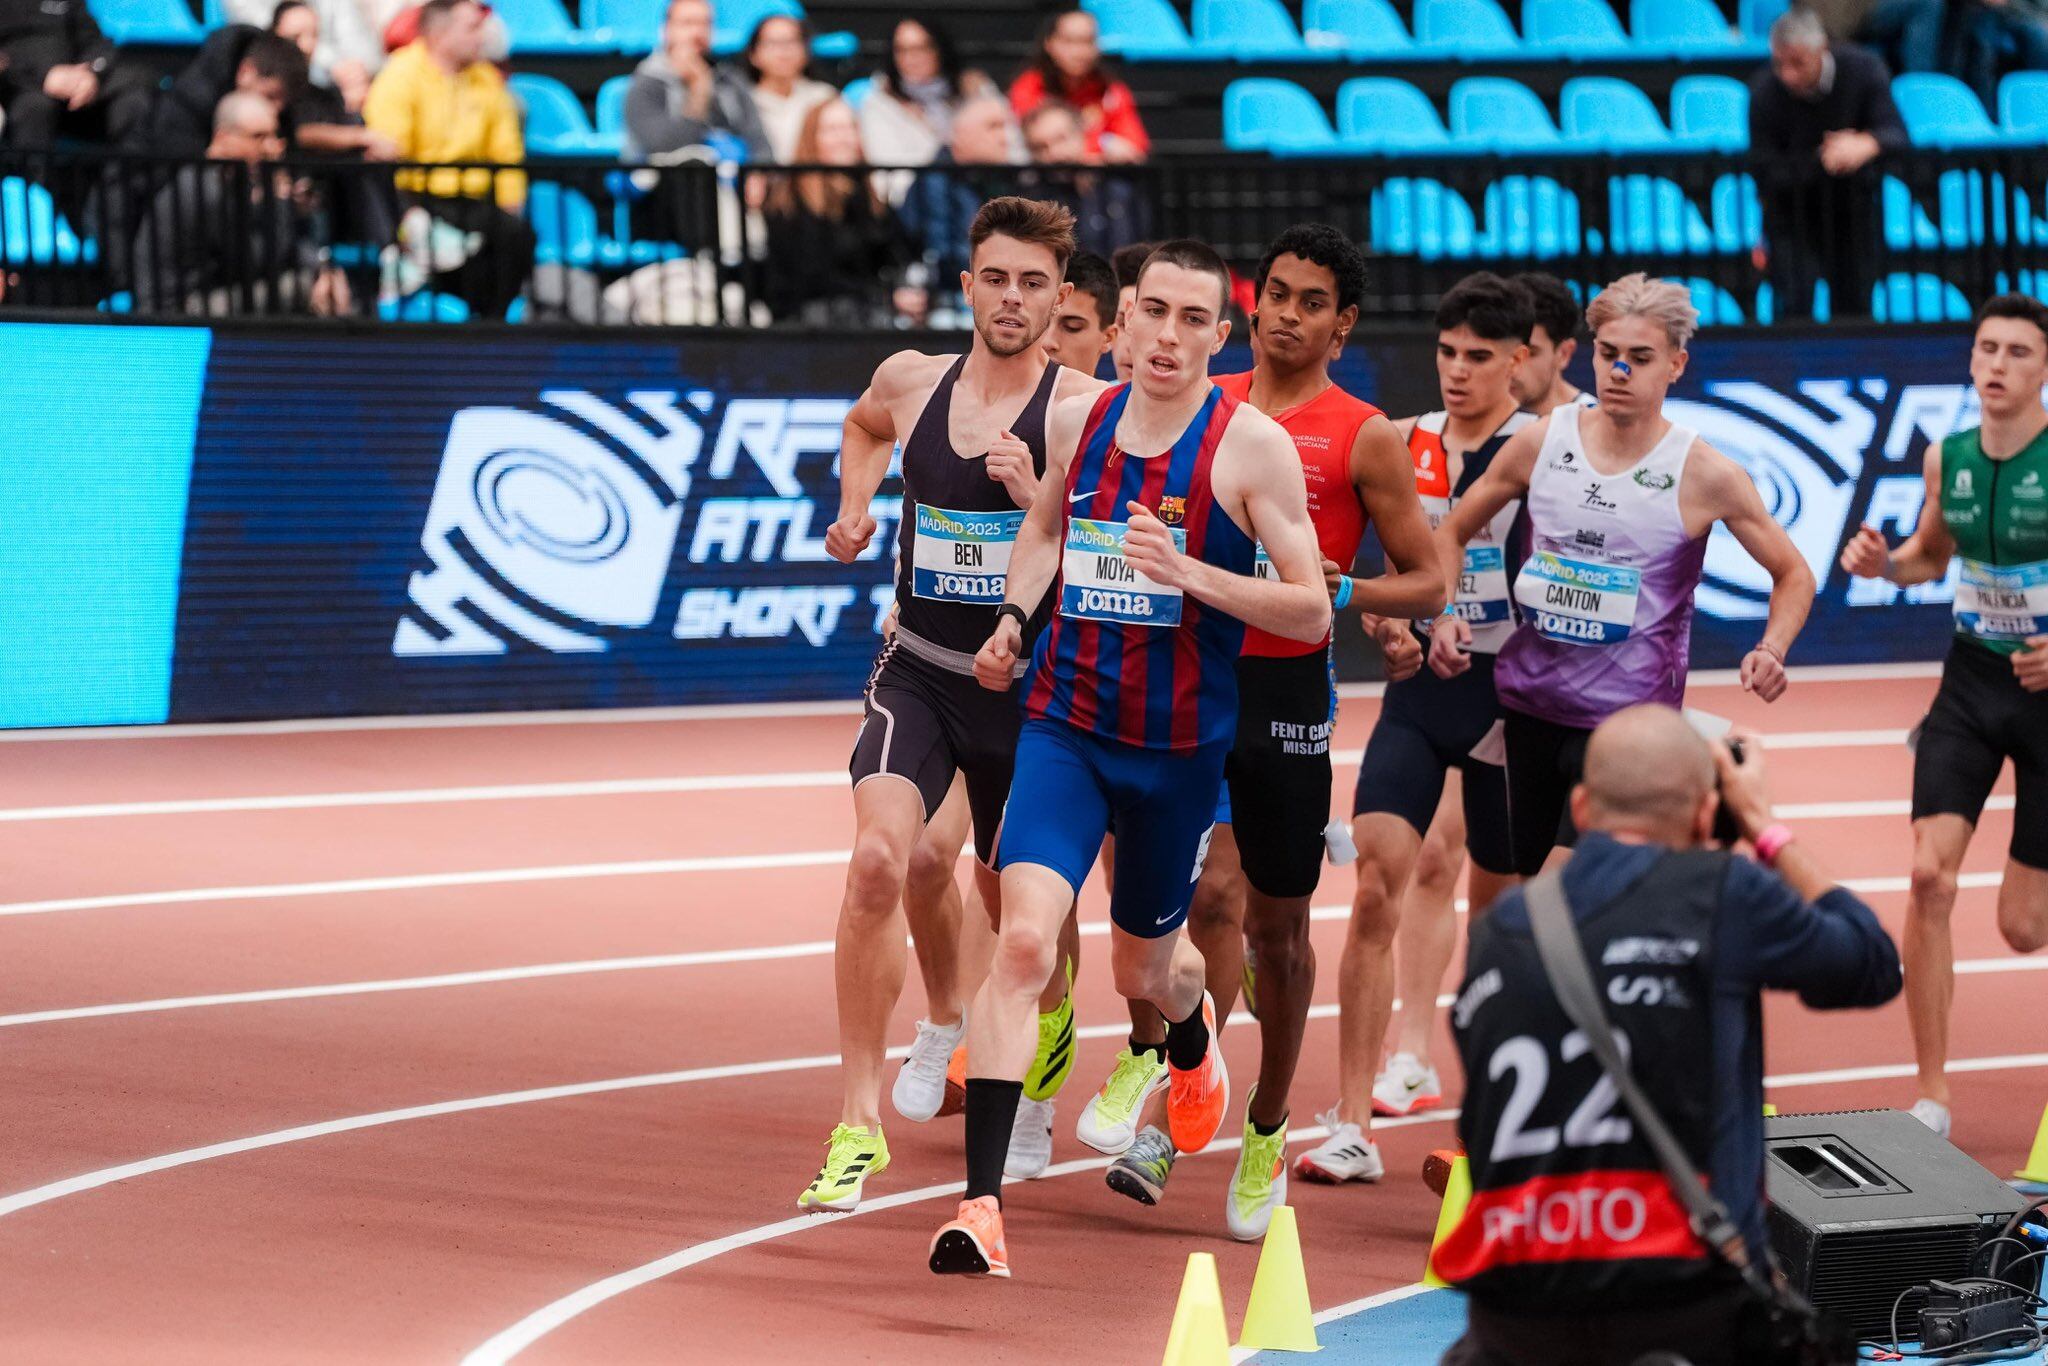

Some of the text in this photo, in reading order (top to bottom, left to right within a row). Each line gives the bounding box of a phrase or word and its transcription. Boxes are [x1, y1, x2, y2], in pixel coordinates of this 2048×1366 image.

[1296, 441, 1328, 450] ENCIANA
[1303, 464, 1320, 473] ació
[1304, 473, 1325, 483] ència
[920, 515, 1001, 536] MADRID 2025
[1069, 529, 1115, 547] MADRID
[955, 543, 983, 567] BEN
[1095, 555, 1135, 583] MOYA
[1576, 569, 1611, 586] 2025
[1546, 584, 1601, 613] CANTON
[671, 586, 857, 647] SHORT
[1271, 720, 1305, 740] FENT
[1488, 1028, 1633, 1163] 22
[1483, 1187, 1647, 1245] PHOTO
